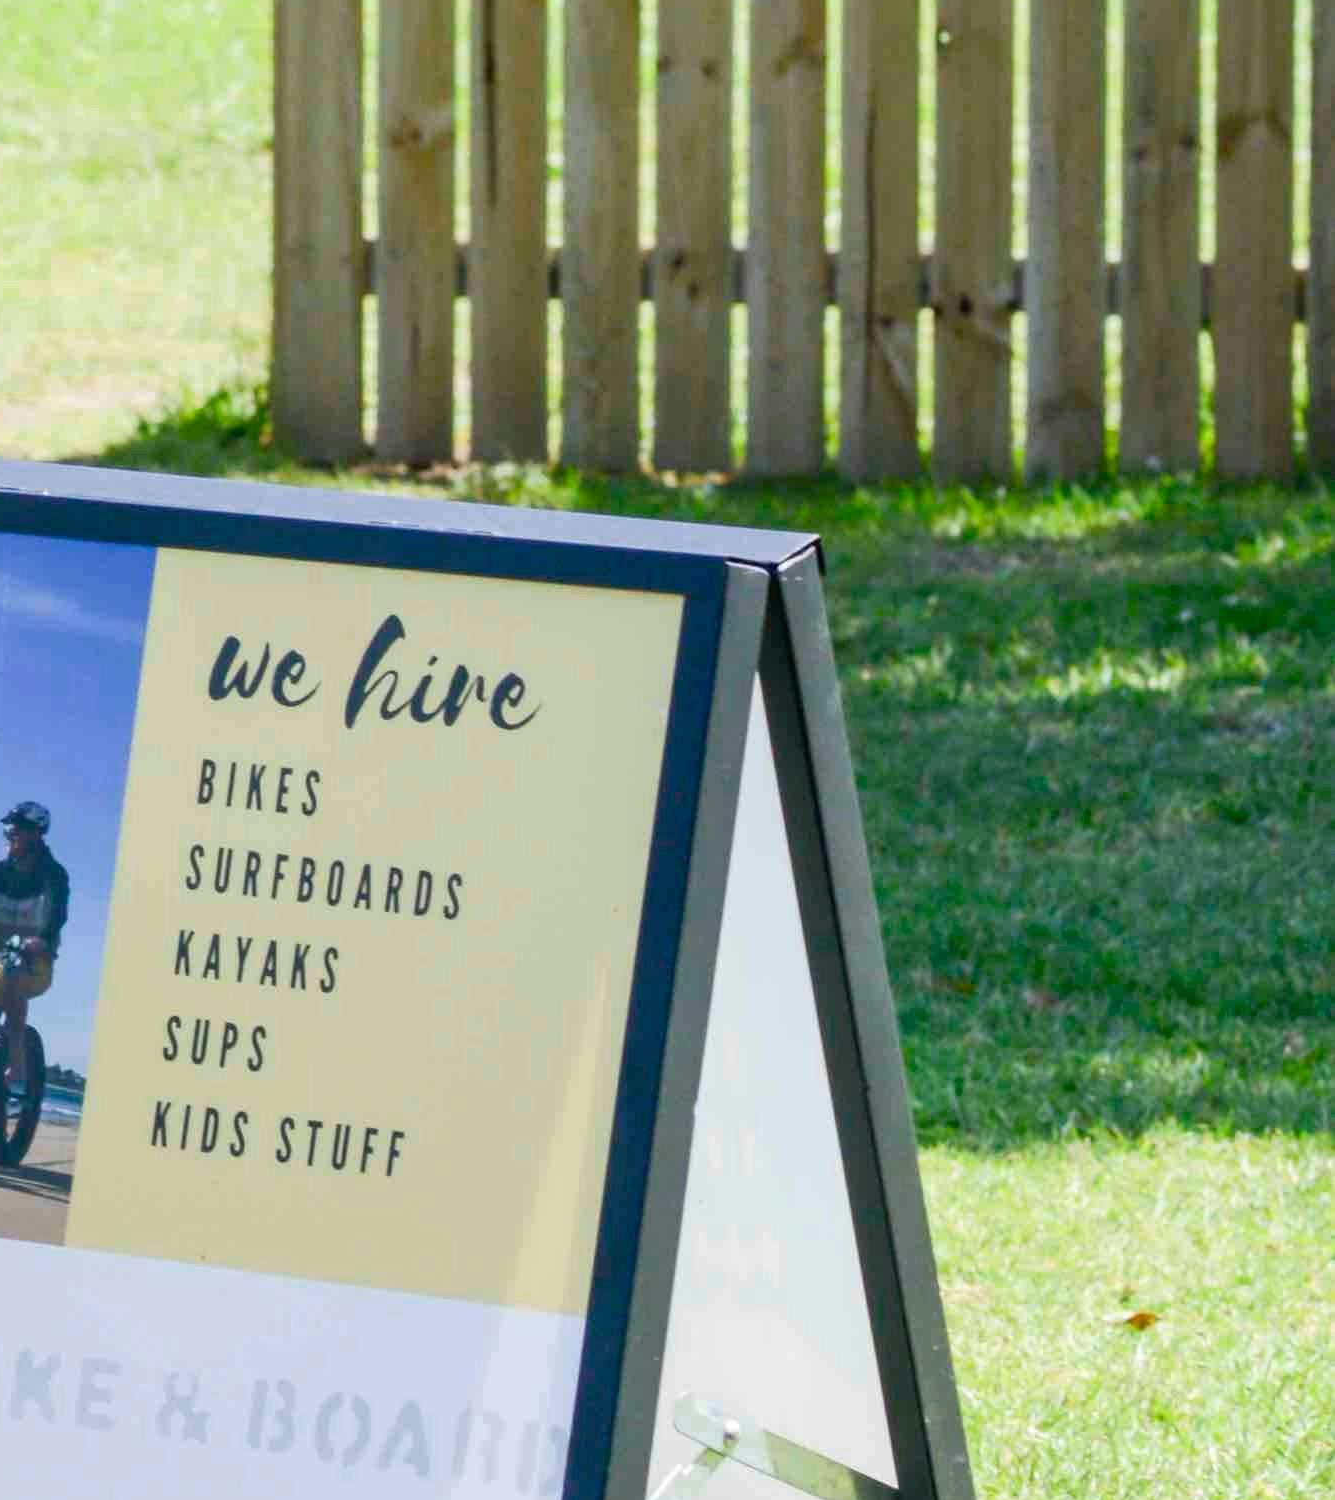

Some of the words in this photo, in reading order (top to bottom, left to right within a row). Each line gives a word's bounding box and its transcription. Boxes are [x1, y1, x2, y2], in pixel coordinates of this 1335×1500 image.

[208, 635, 322, 708] we
[343, 613, 543, 731] hire
[197, 759, 321, 816] BIKES
[185, 845, 463, 920] SURFBOARDS
[174, 929, 340, 993] KAYAKS
[162, 1016, 267, 1072] SUPS
[150, 1101, 249, 1157] KIDS
[275, 1117, 406, 1177] STUFF
[155, 1370, 211, 1444] &
